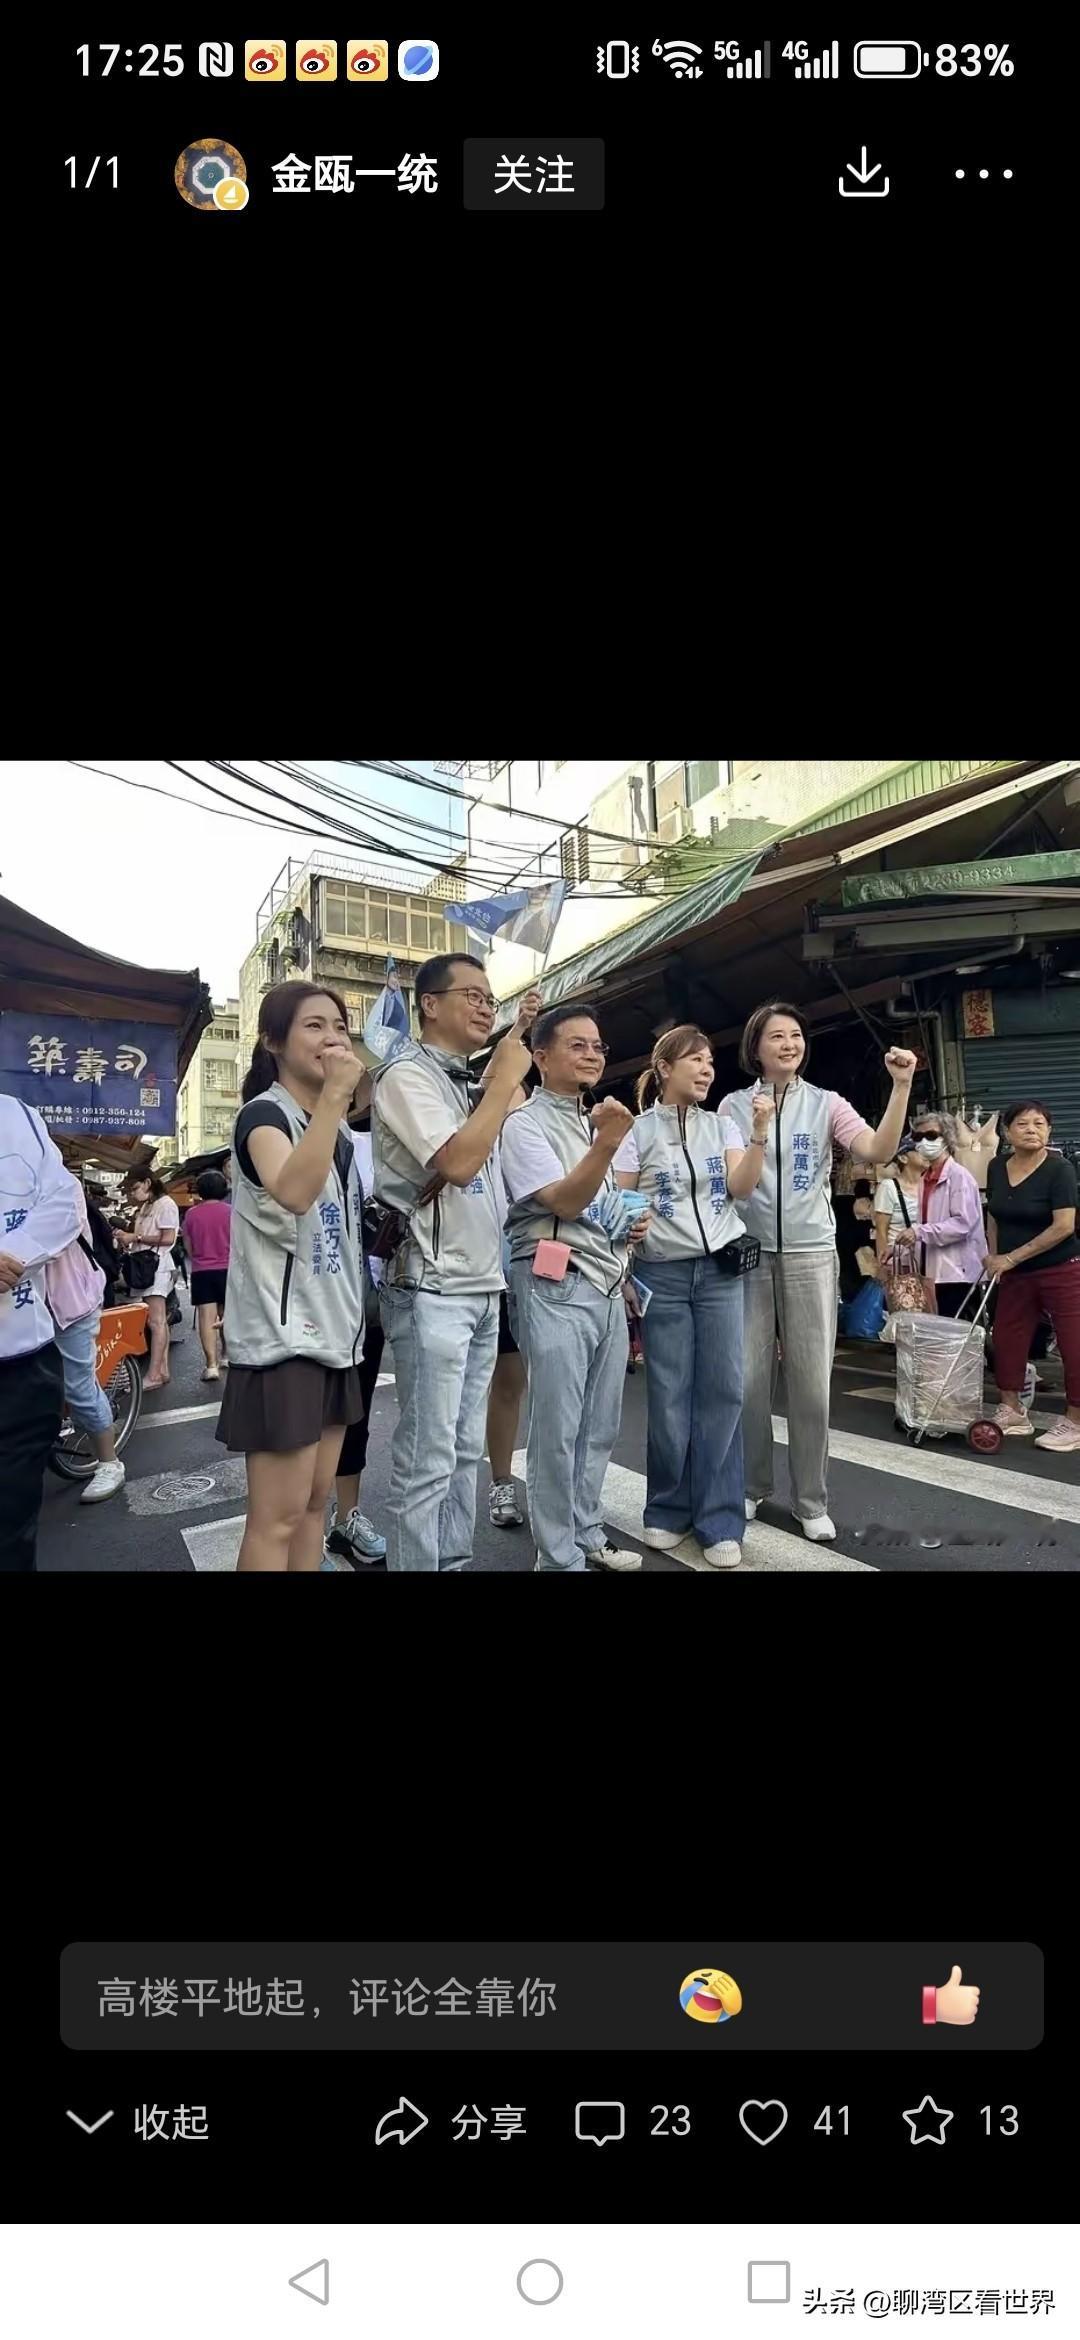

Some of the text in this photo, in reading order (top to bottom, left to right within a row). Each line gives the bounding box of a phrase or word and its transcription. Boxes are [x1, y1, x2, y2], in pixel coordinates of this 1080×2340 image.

[76, 43, 185, 77] 17:25
[713, 40, 740, 61] 5G
[781, 40, 808, 61] 4G
[935, 43, 1015, 77] 83%
[64, 155, 122, 190] 1/1
[270, 152, 439, 195] 金瓯一统
[493, 154, 575, 194] 关注
[792, 1132, 811, 1191] 蔣萬安
[705, 1156, 726, 1216] 蔣萬安
[319, 1201, 341, 1275] 徐巧芯
[97, 1976, 557, 2019] 高楼平地起，评论全靠你
[134, 2103, 209, 2141] 收起
[451, 2103, 527, 2141] 分享
[650, 2104, 691, 2136] 23
[813, 2104, 850, 2136] 41
[980, 2104, 1019, 2136] 13
